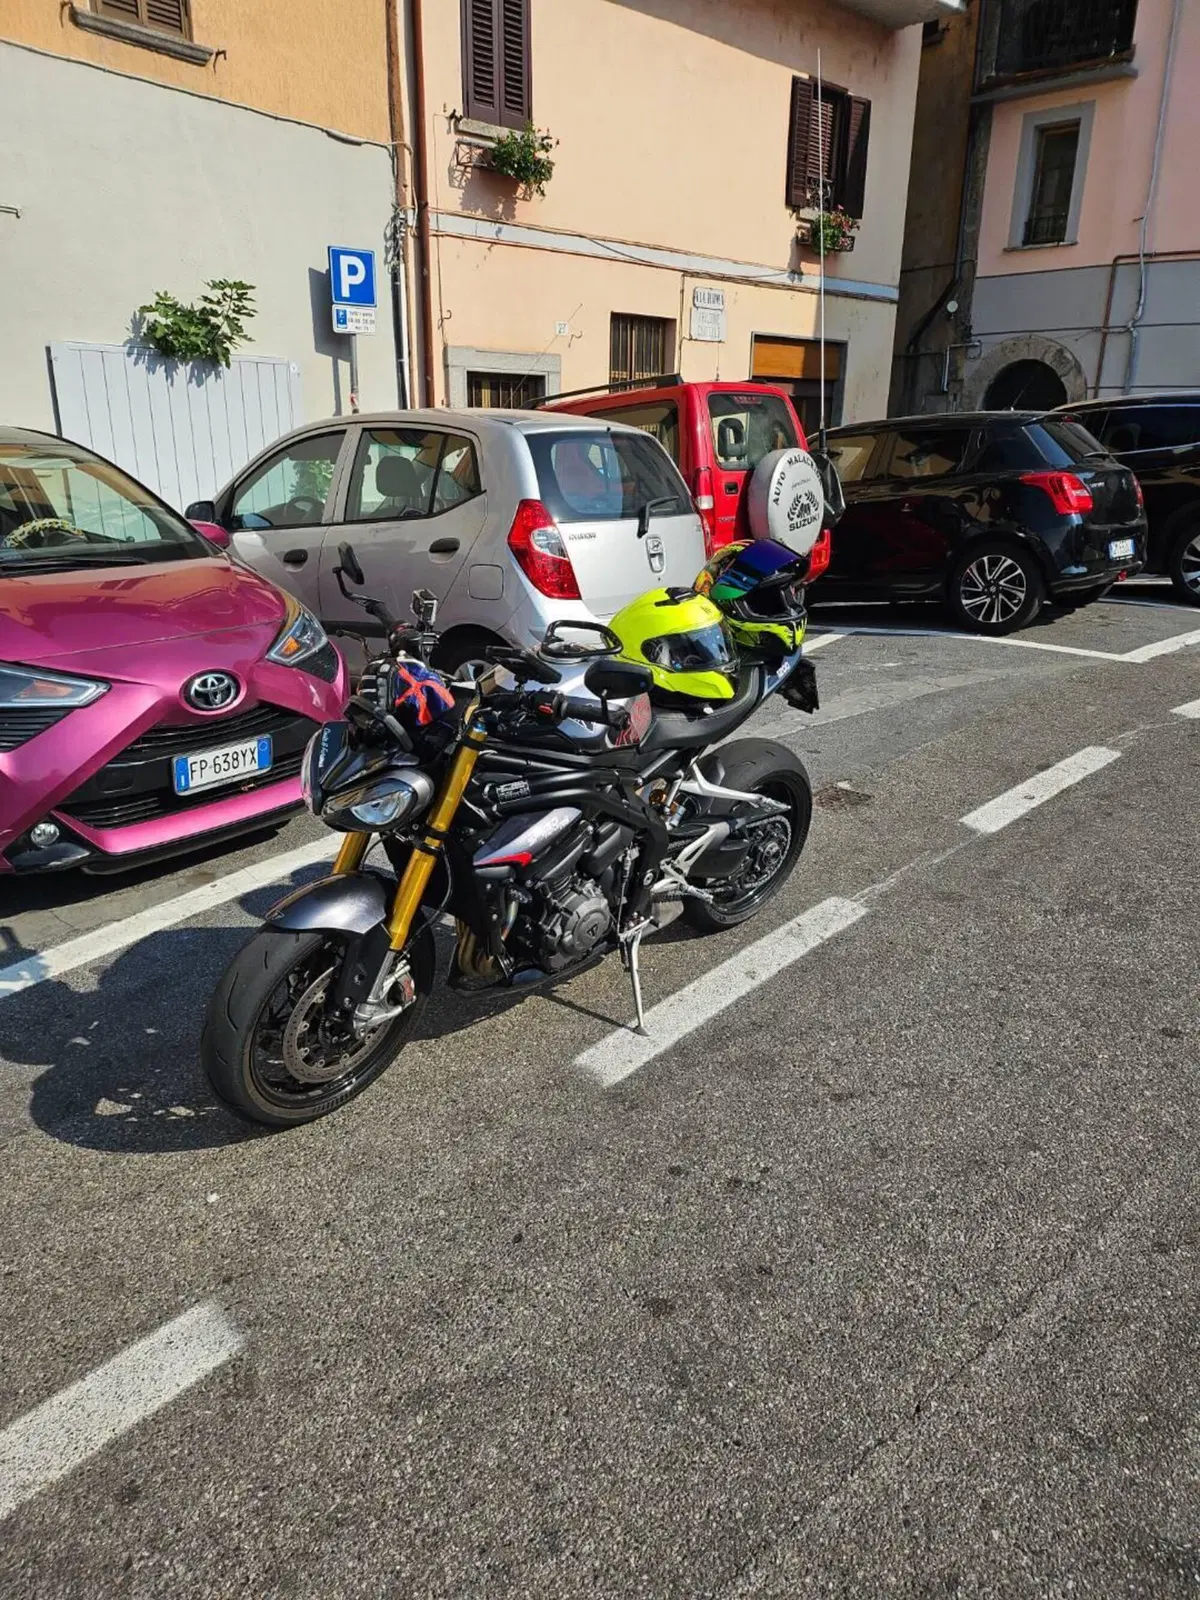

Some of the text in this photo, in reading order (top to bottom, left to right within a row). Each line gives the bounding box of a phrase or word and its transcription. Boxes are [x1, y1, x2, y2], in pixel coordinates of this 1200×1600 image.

[339, 254, 366, 298] P
[772, 470, 787, 507] AUTO
[788, 512, 821, 532] SUZUKI
